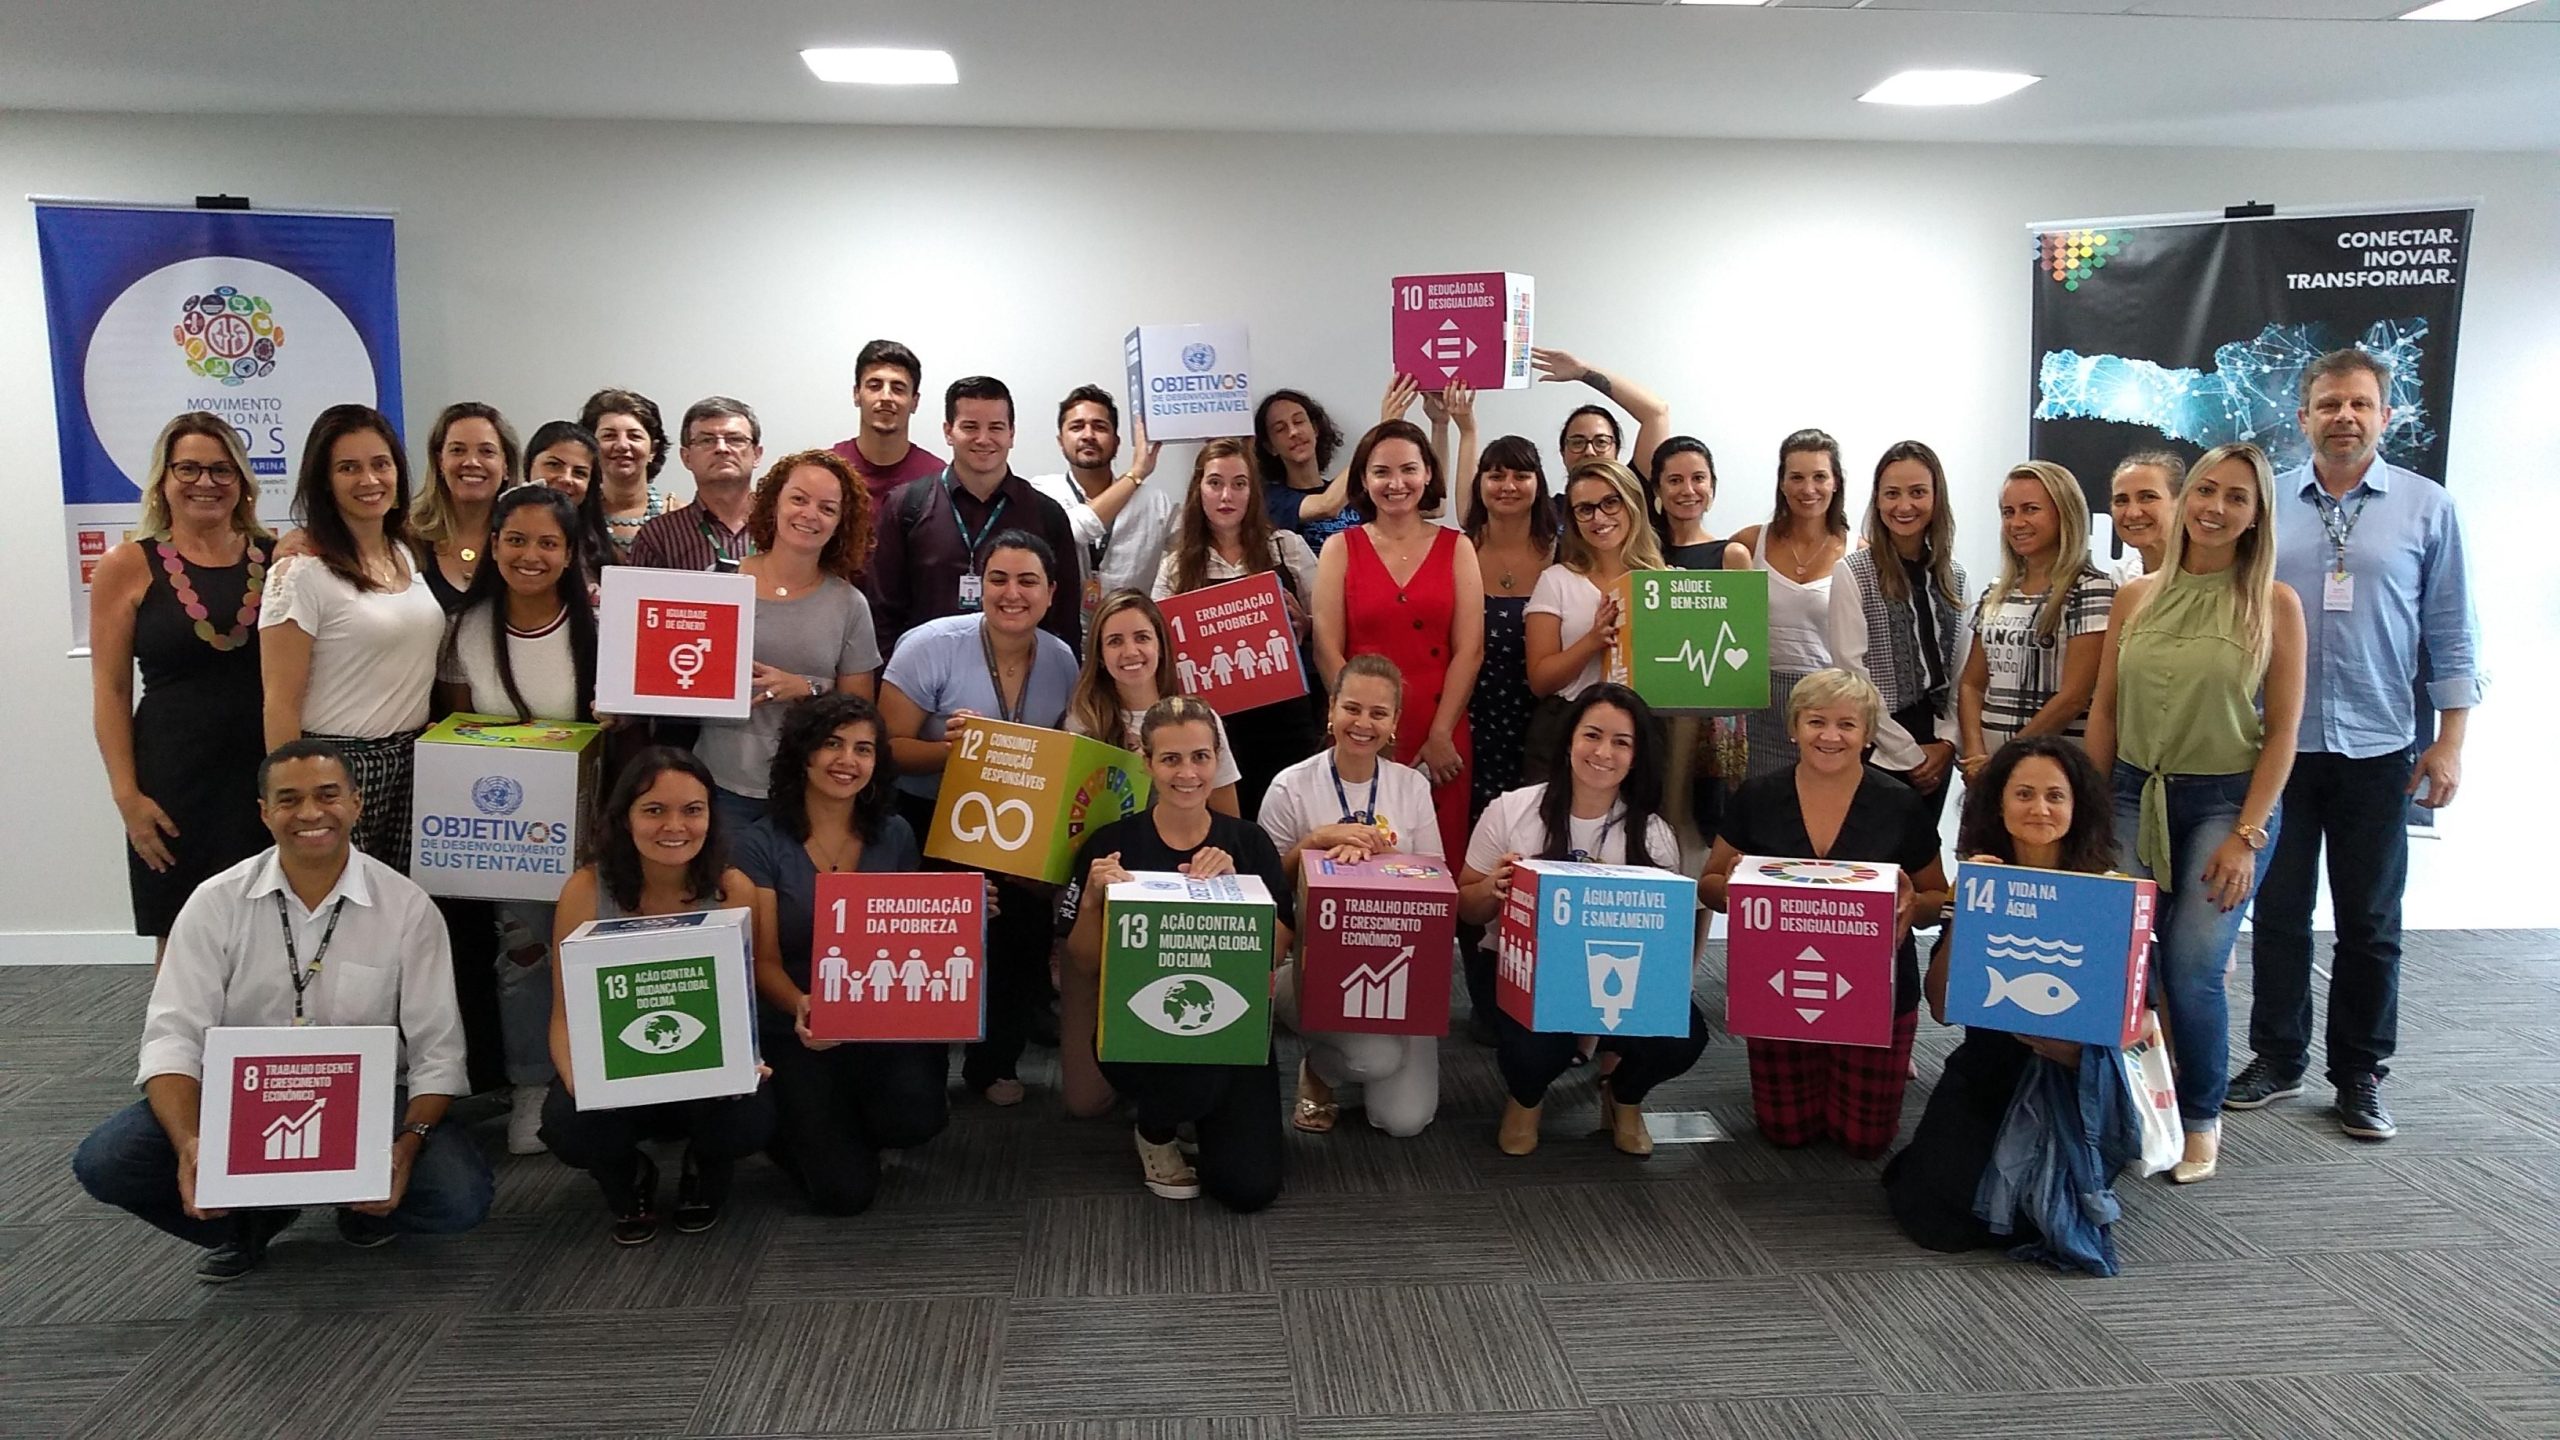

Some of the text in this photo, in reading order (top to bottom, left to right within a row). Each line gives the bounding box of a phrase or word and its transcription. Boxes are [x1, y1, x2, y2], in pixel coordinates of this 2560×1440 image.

[2337, 228, 2459, 249] CONECTAR.
[2363, 249, 2458, 267] INOVAR.
[2286, 268, 2457, 290] TRANSFORMAR.
[1401, 285, 1423, 311] 10
[1428, 282, 1485, 297] REDUÇÃO DAS
[1428, 296, 1495, 310] DESIGUALDADES
[1151, 373, 1248, 393] OBJETIVOS
[187, 398, 282, 411] MOVIMENTO
[1644, 580, 1660, 610] 3
[1670, 578, 1712, 593] SAÚDE E
[666, 608, 708, 619] IGUALDADE
[1195, 592, 1274, 622] ERRADICAÇÃO
[1670, 597, 1728, 610] BEM-ESTAR
[646, 607, 659, 628] 5
[665, 620, 675, 629] DE
[1199, 610, 1269, 637] DA POBREZA
[1171, 615, 1186, 643] 1
[960, 728, 984, 761] 12
[990, 733, 1039, 753] CONSUMO E
[985, 750, 1034, 771] PRODUÇÃO
[980, 766, 1046, 791] RESPONSÁVEIS
[421, 815, 567, 844] OBJETIVOS
[421, 838, 566, 856] DE DESENVOLVIMENTO
[420, 851, 566, 874] SUSTENTÁVEL
[1582, 886, 1667, 909] ÁGUA POTÁVEL
[1964, 877, 1996, 914] 14
[2008, 881, 2058, 901] VIDA NA
[832, 898, 847, 933] 1
[866, 897, 972, 915] ERRADICAÇÃO
[1319, 898, 1337, 930] 8
[1345, 899, 1449, 917] TRABALHO DECENTE
[1552, 887, 1572, 926] 6
[1740, 897, 1772, 931] 10
[1780, 898, 1865, 918] REDUÇÃO DAS
[2005, 899, 2038, 919] ÁGUA
[866, 918, 958, 934] DA POBREZA
[1160, 912, 1257, 932] AÇÃO CONTRA A
[1342, 915, 1422, 932] E CRESCIMENTO
[1582, 910, 1665, 930] E SANEAMENTO
[1780, 917, 1879, 937] DESIGUALDADES
[1118, 913, 1149, 949] 13
[1342, 931, 1402, 948] ECONÔMICO
[1159, 934, 1262, 952] MUDANÇA GLOBAL
[1158, 952, 1212, 968] DO CLIMA
[634, 967, 705, 983] AÇÃO CONTRA A
[604, 974, 629, 1000] 13
[635, 979, 710, 997] MUDANÇA GLOBAL
[636, 996, 675, 1009] DO CLIMA
[243, 1066, 259, 1091] 8
[265, 1062, 354, 1076] TRABALHO DECENTE
[263, 1076, 332, 1089] E CRESCIMENTO
[262, 1089, 315, 1102] ECONÔMICO
